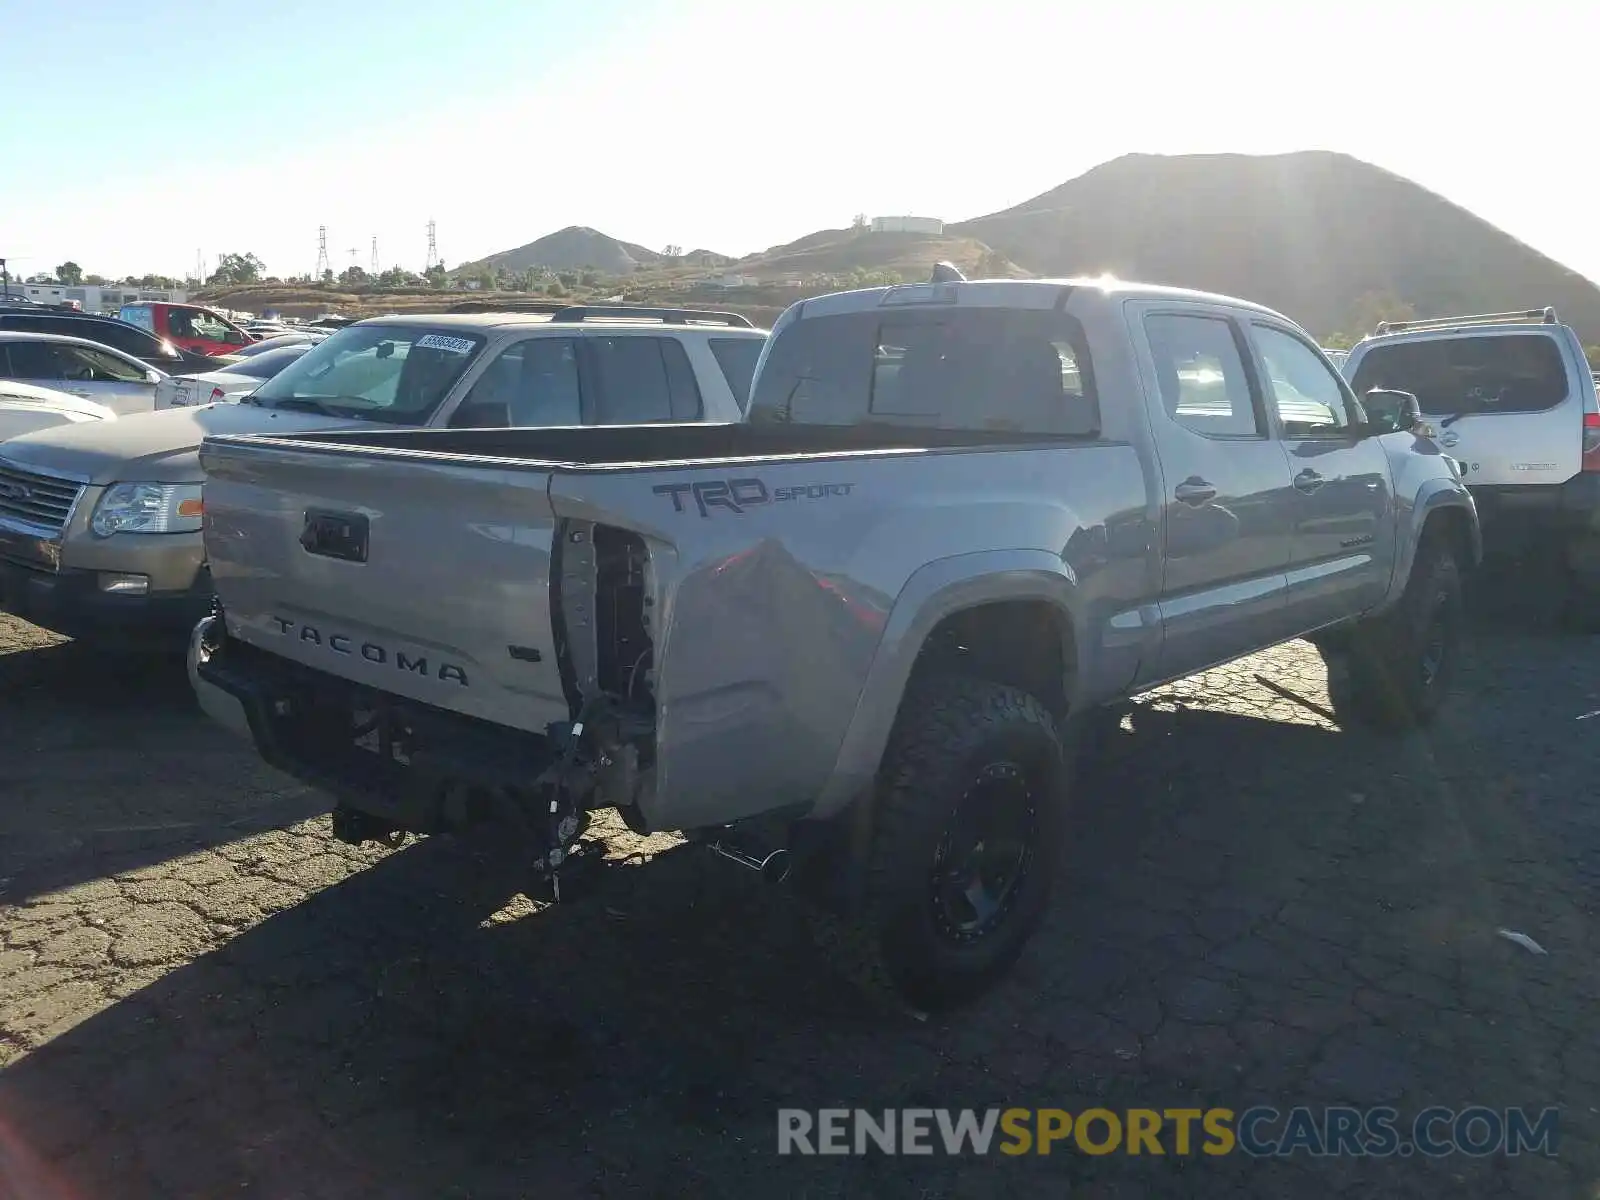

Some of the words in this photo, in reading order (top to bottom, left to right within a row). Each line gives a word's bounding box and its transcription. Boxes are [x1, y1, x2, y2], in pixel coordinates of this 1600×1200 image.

[652, 478, 769, 517] TRD
[774, 483, 855, 502] SPORT
[274, 616, 469, 687] TACOMA
